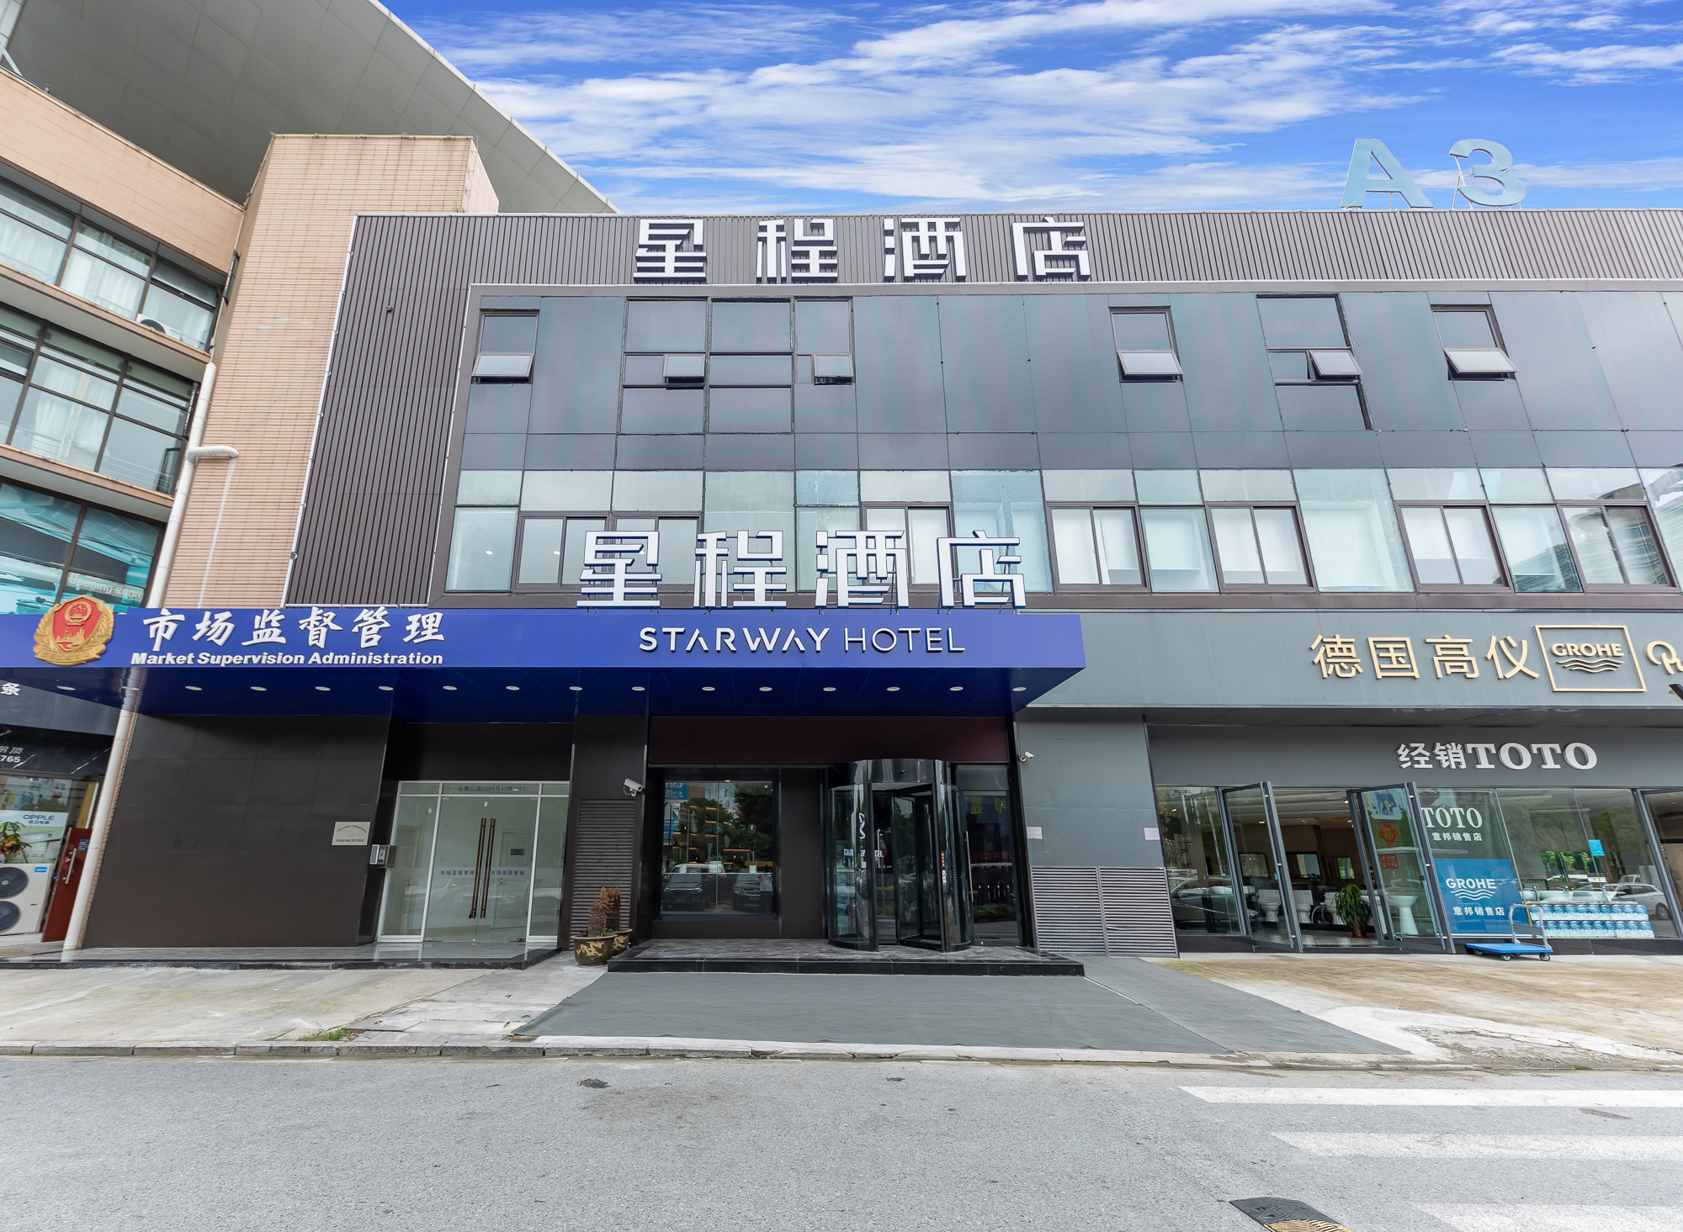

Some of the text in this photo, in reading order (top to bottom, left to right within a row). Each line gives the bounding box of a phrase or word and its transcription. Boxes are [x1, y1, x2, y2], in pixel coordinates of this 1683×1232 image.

[1339, 138, 1527, 208] A3
[633, 216, 1092, 283] 星程酒店
[576, 529, 1028, 610] 星程酒店
[143, 606, 446, 652] 市场监督管理
[639, 627, 967, 653] STARWAY HOTEL
[130, 651, 444, 667] Market Supervision Administration
[1309, 634, 1541, 681] 德国高仪
[1551, 642, 1625, 658] GROHE
[1420, 807, 1483, 829] TOTO
[1445, 878, 1498, 890] GROHE
